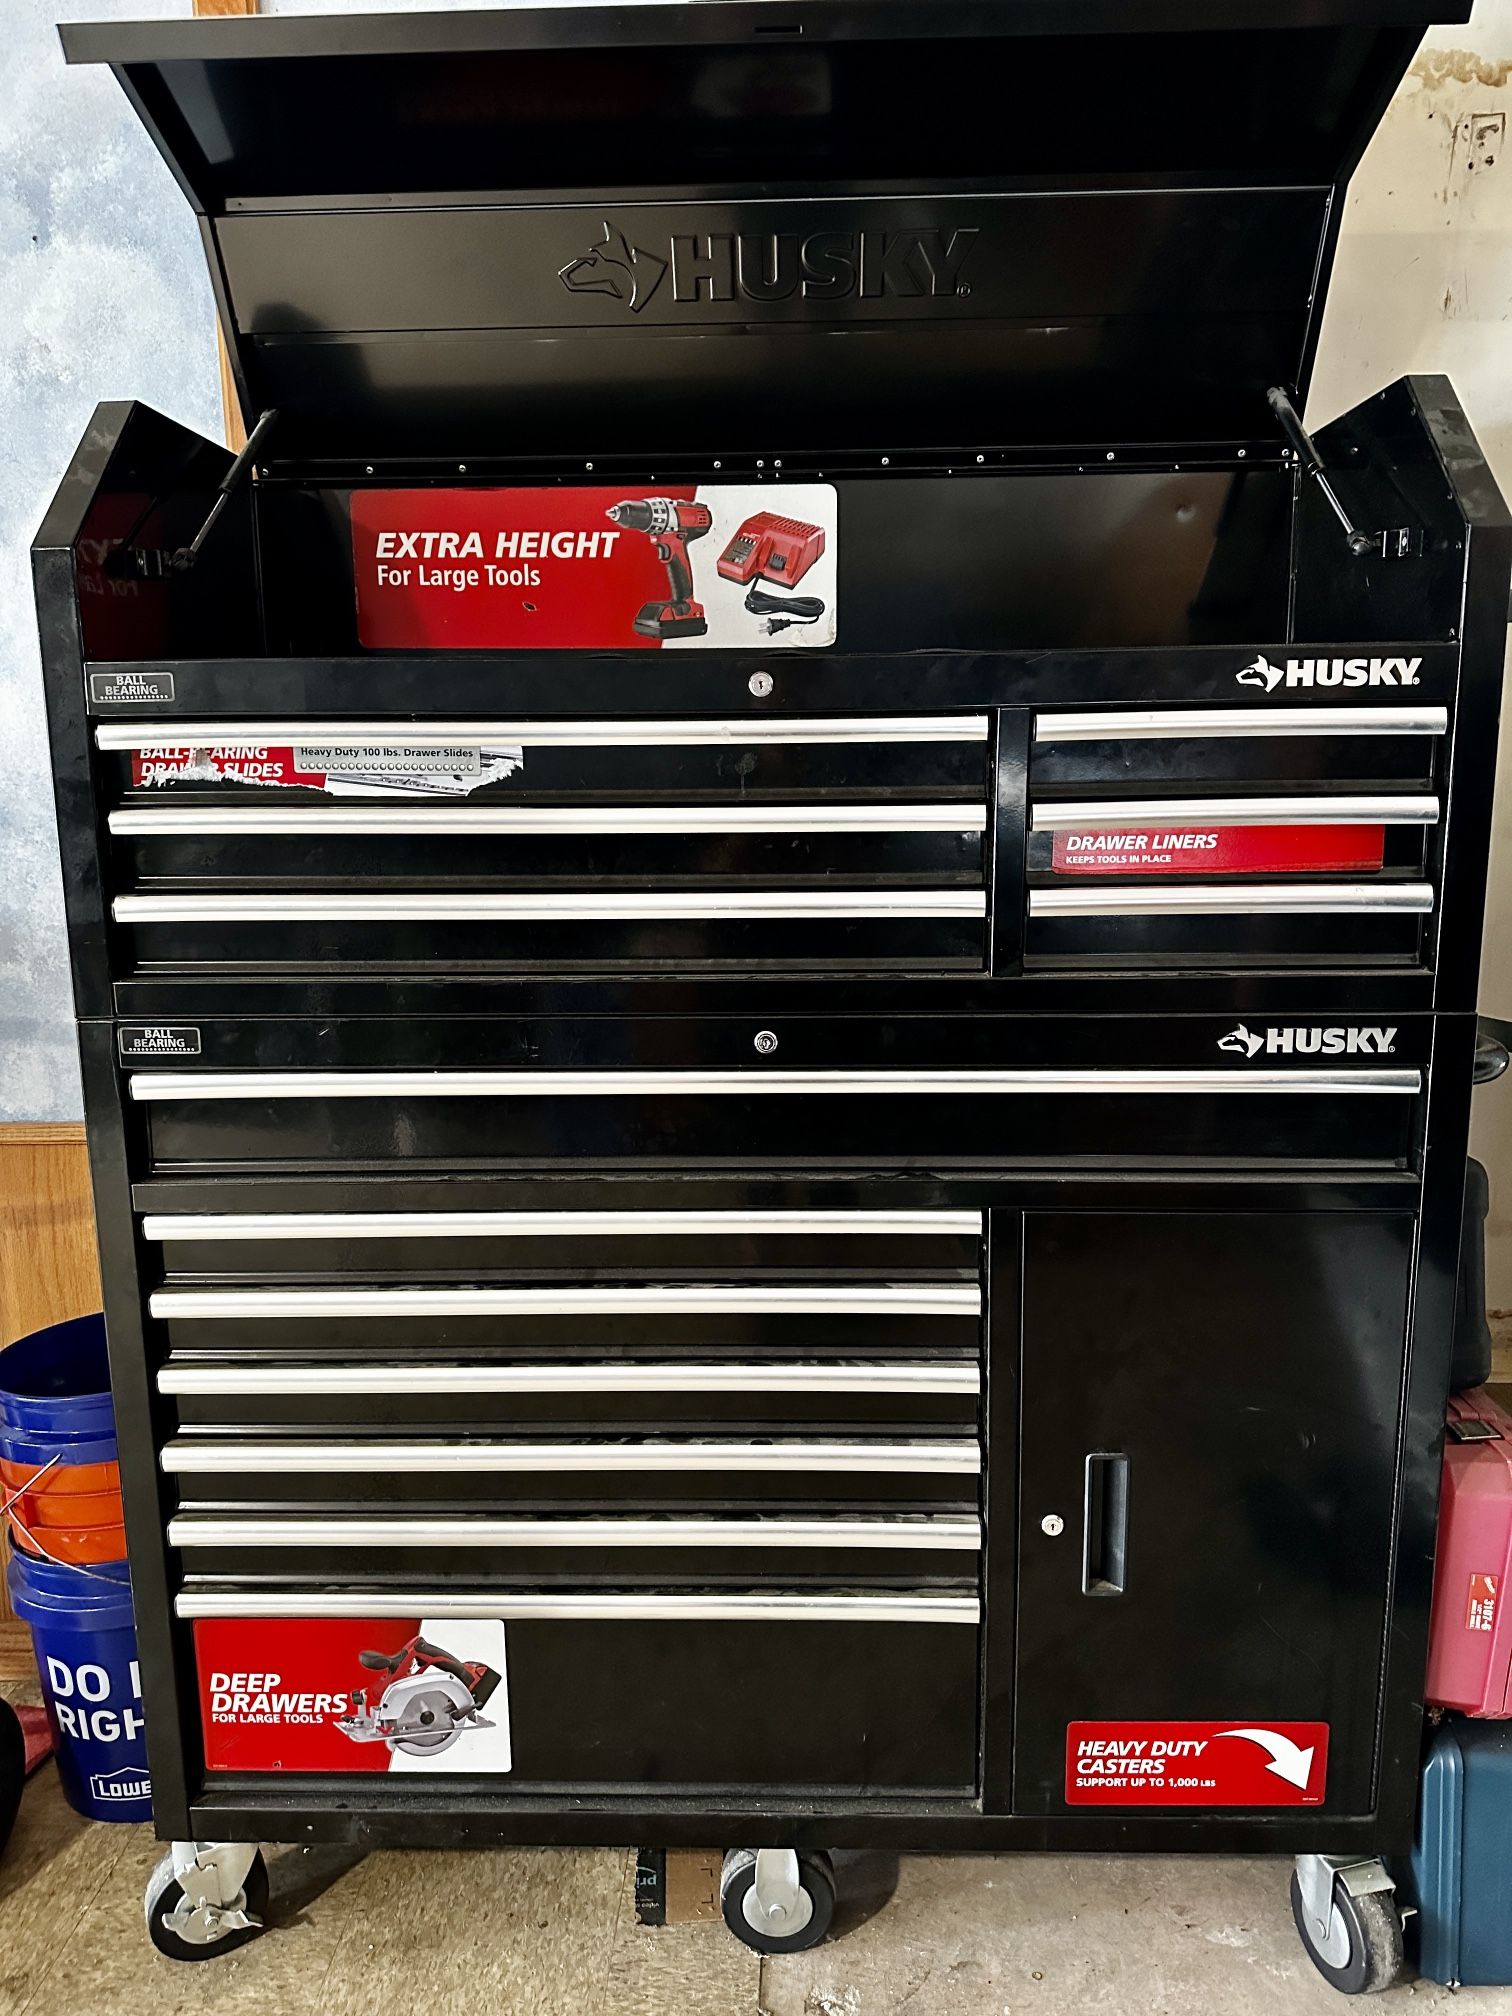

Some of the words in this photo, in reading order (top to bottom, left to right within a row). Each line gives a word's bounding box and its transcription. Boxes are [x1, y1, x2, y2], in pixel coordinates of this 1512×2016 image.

[669, 227, 980, 302] HUSKY
[375, 531, 485, 559] EXTRA
[495, 531, 621, 558] HEIGHT
[377, 565, 411, 586] For
[418, 564, 479, 591] Large
[484, 563, 541, 586] Tools
[116, 675, 146, 686] BALL
[1286, 657, 1422, 687] HUSKY
[105, 685, 158, 695] BEARING
[139, 746, 268, 759] BALL-ARING
[301, 747, 331, 757] Heavy
[335, 747, 359, 757] Duty
[363, 748, 381, 757] 100
[383, 747, 401, 757] lbs.
[404, 748, 439, 758] Drawer
[443, 748, 474, 758] Slides
[223, 762, 284, 778] SLIDES
[1066, 835, 1148, 851] DRAWER
[1152, 833, 1218, 850] LINERS
[1066, 855, 1095, 864] KEEPS
[1097, 855, 1127, 864] TOOLS
[1129, 855, 1140, 863] IN
[1142, 854, 1172, 863] PLACE
[144, 1029, 173, 1038] BALL
[1266, 1027, 1398, 1054] HUSKY
[133, 1038, 185, 1048] BEARING
[47, 1655, 111, 1702] DO
[210, 1672, 281, 1693] DEEP
[211, 1693, 349, 1714] DRAWERS
[212, 1713, 237, 1723] FOR
[240, 1713, 281, 1723] LARGE
[284, 1713, 324, 1724] TOOLS
[1077, 1740, 1148, 1757] HEAVY
[1150, 1740, 1208, 1757] DUTY
[1076, 1758, 1166, 1775] CASTERS
[1076, 1777, 1128, 1787] SUPPORT
[1130, 1777, 1147, 1787] UP
[1150, 1777, 1165, 1787] TO
[1168, 1777, 1199, 1788] 1,000
